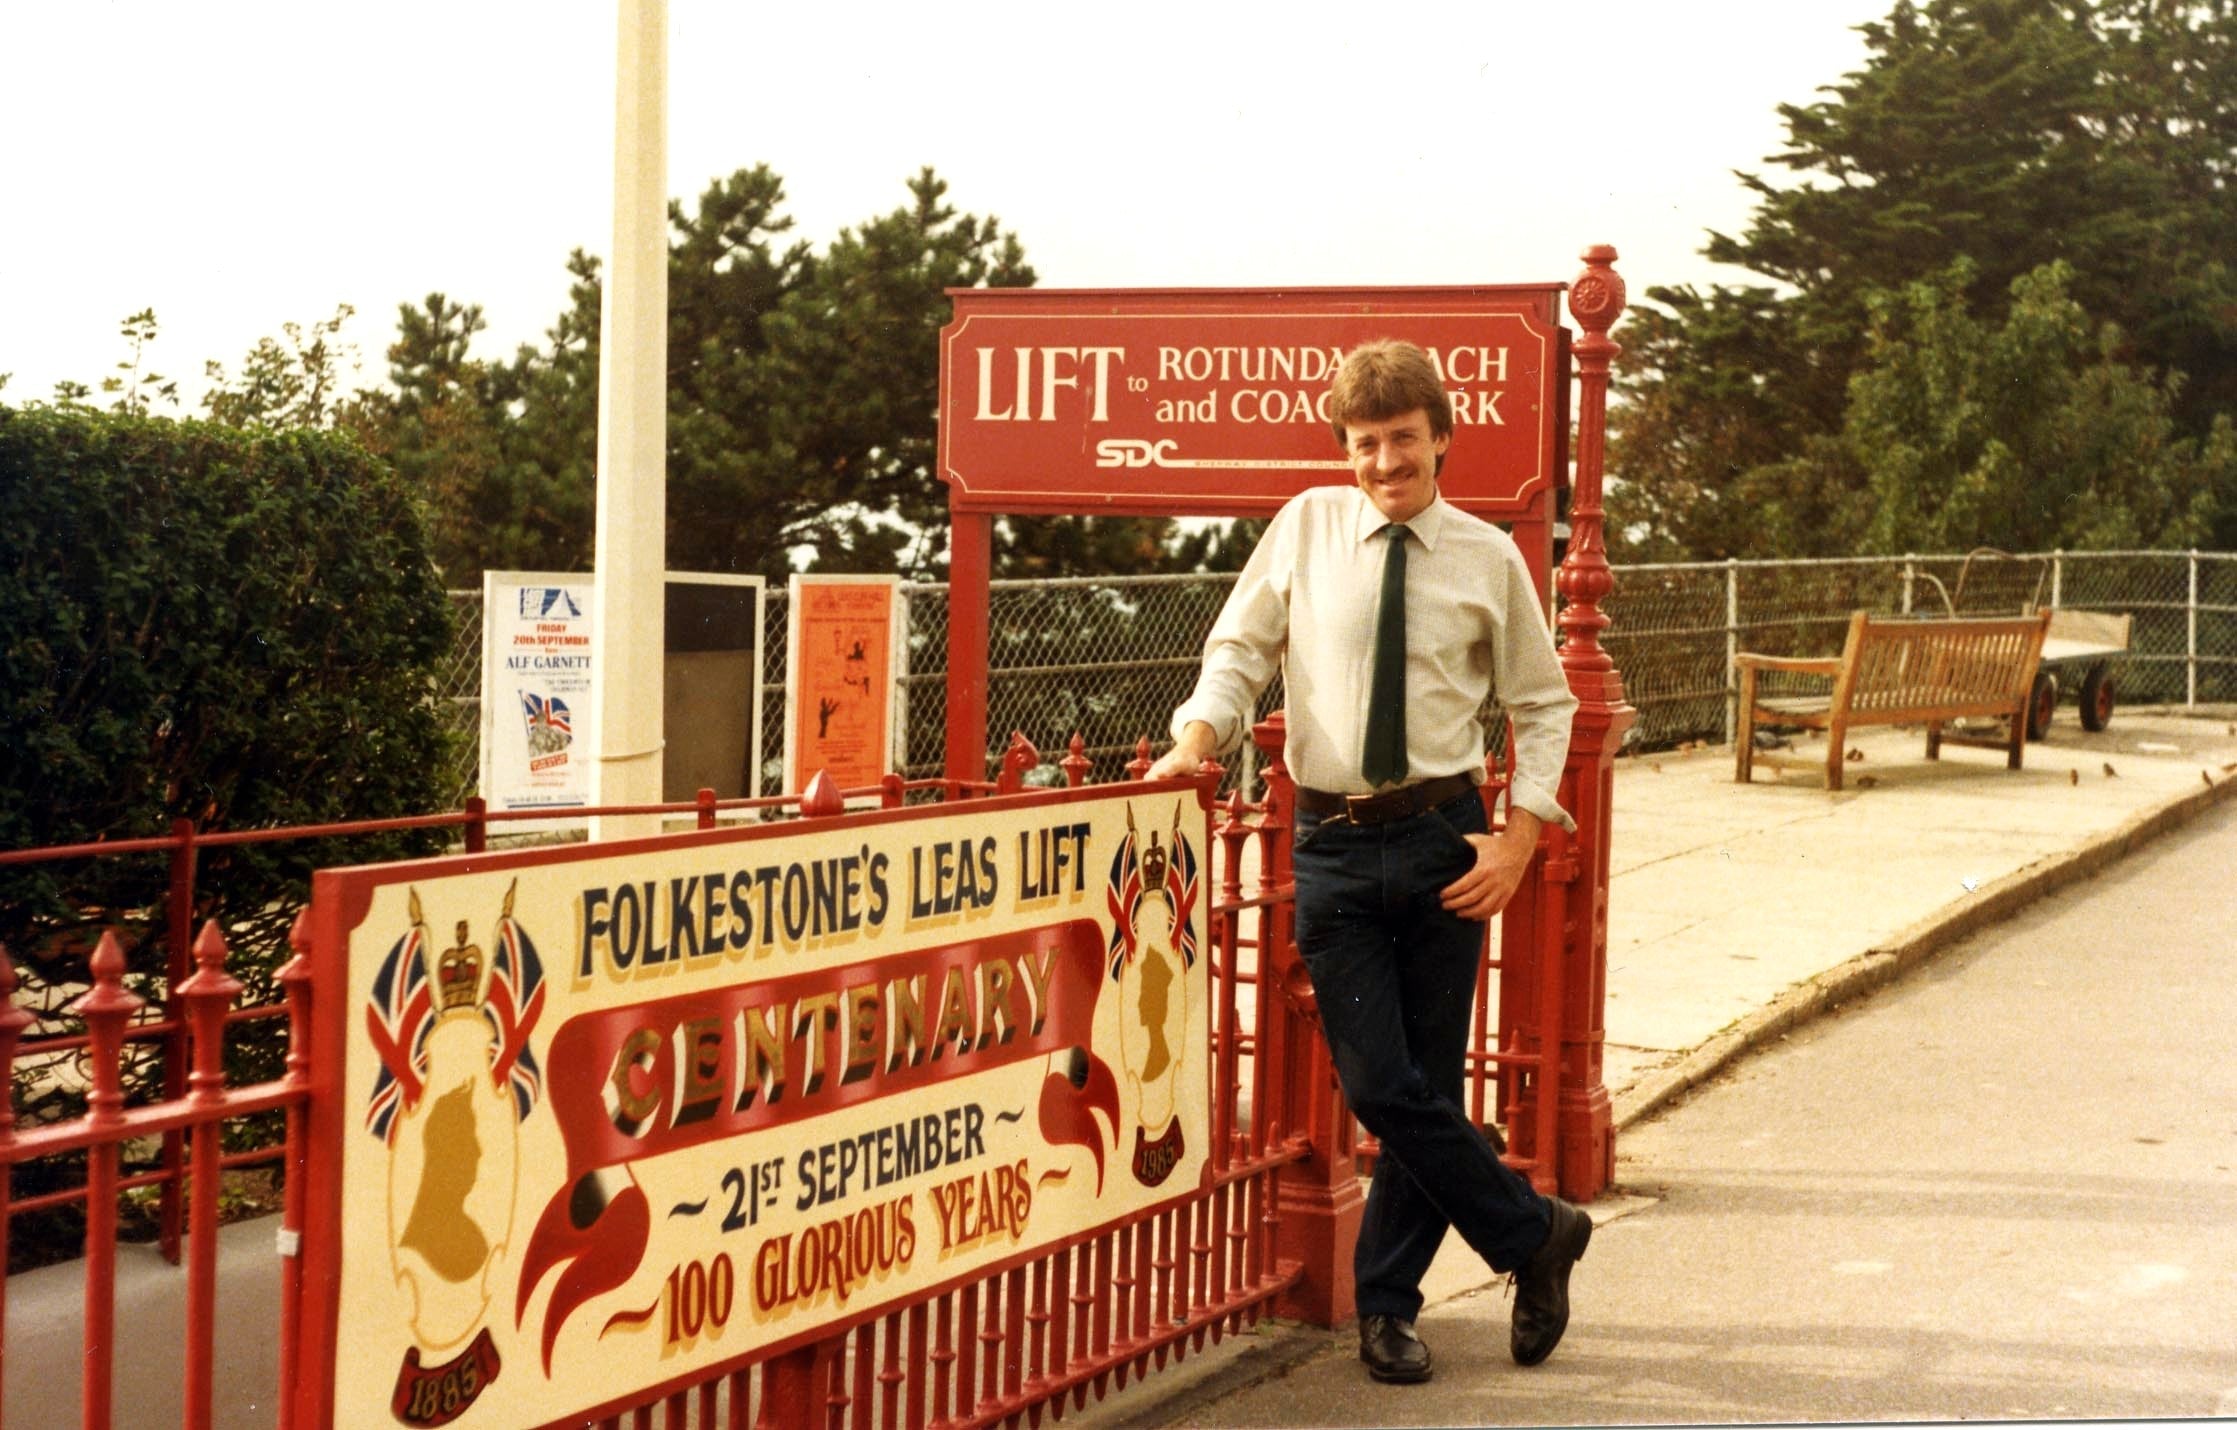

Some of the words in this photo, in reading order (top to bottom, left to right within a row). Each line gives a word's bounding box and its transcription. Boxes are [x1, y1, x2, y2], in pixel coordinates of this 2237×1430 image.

[973, 346, 1125, 422] LIFT
[1127, 374, 1149, 392] to
[1158, 346, 1344, 382] ROTUNDA
[1425, 345, 1509, 382] ACH
[1155, 388, 1218, 423] and
[1230, 388, 1333, 424] COAC
[1447, 391, 1505, 425] RK
[1096, 438, 1178, 468] SDC
[513, 634, 535, 646] 20th
[537, 635, 590, 646] SEPTEMBER
[536, 623, 567, 633] FRIDAY
[506, 655, 531, 669] ALF
[534, 655, 592, 669] GARNETT
[578, 843, 889, 979] FOLKESTONE'S
[911, 836, 998, 920] LEAS
[1019, 822, 1092, 901] LIFT
[602, 946, 1060, 1137] CENTENARY
[720, 1157, 785, 1234] 21ST
[796, 1102, 986, 1212] SEPTEMBER
[1142, 1139, 1175, 1178] 1985
[667, 1251, 734, 1345] 100
[754, 1194, 916, 1312] GLORIOUS
[931, 1158, 1032, 1250] YEARS
[408, 1355, 478, 1419] 1885
